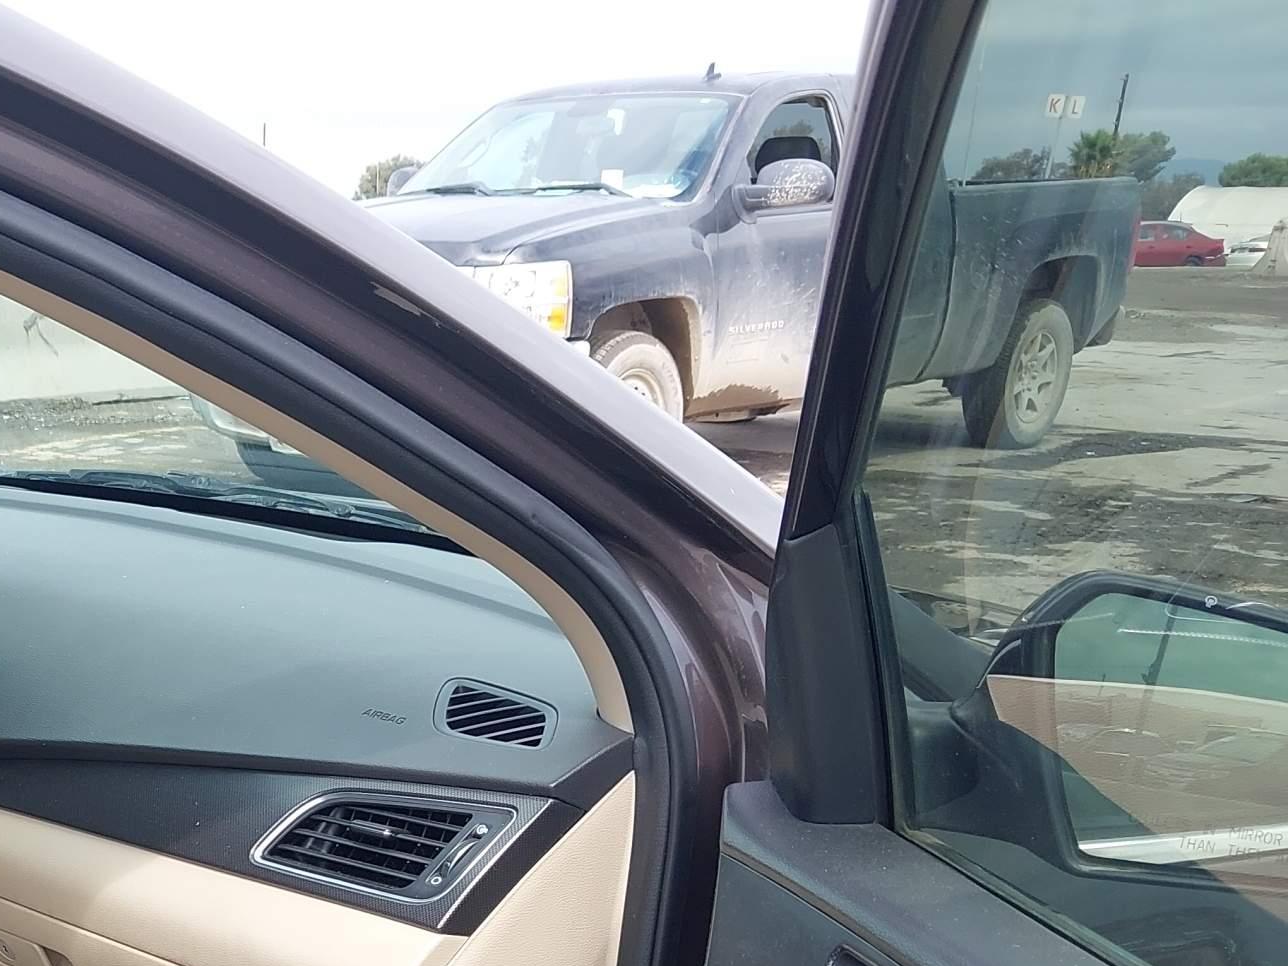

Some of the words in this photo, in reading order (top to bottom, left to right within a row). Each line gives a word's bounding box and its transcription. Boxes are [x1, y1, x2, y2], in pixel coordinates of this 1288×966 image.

[1049, 98, 1061, 113] K
[1072, 99, 1081, 115] L
[728, 319, 784, 334] SILVERADO
[361, 708, 407, 725] AIRBAG
[1228, 826, 1284, 847] MIRROR
[1179, 837, 1216, 854] THAN
